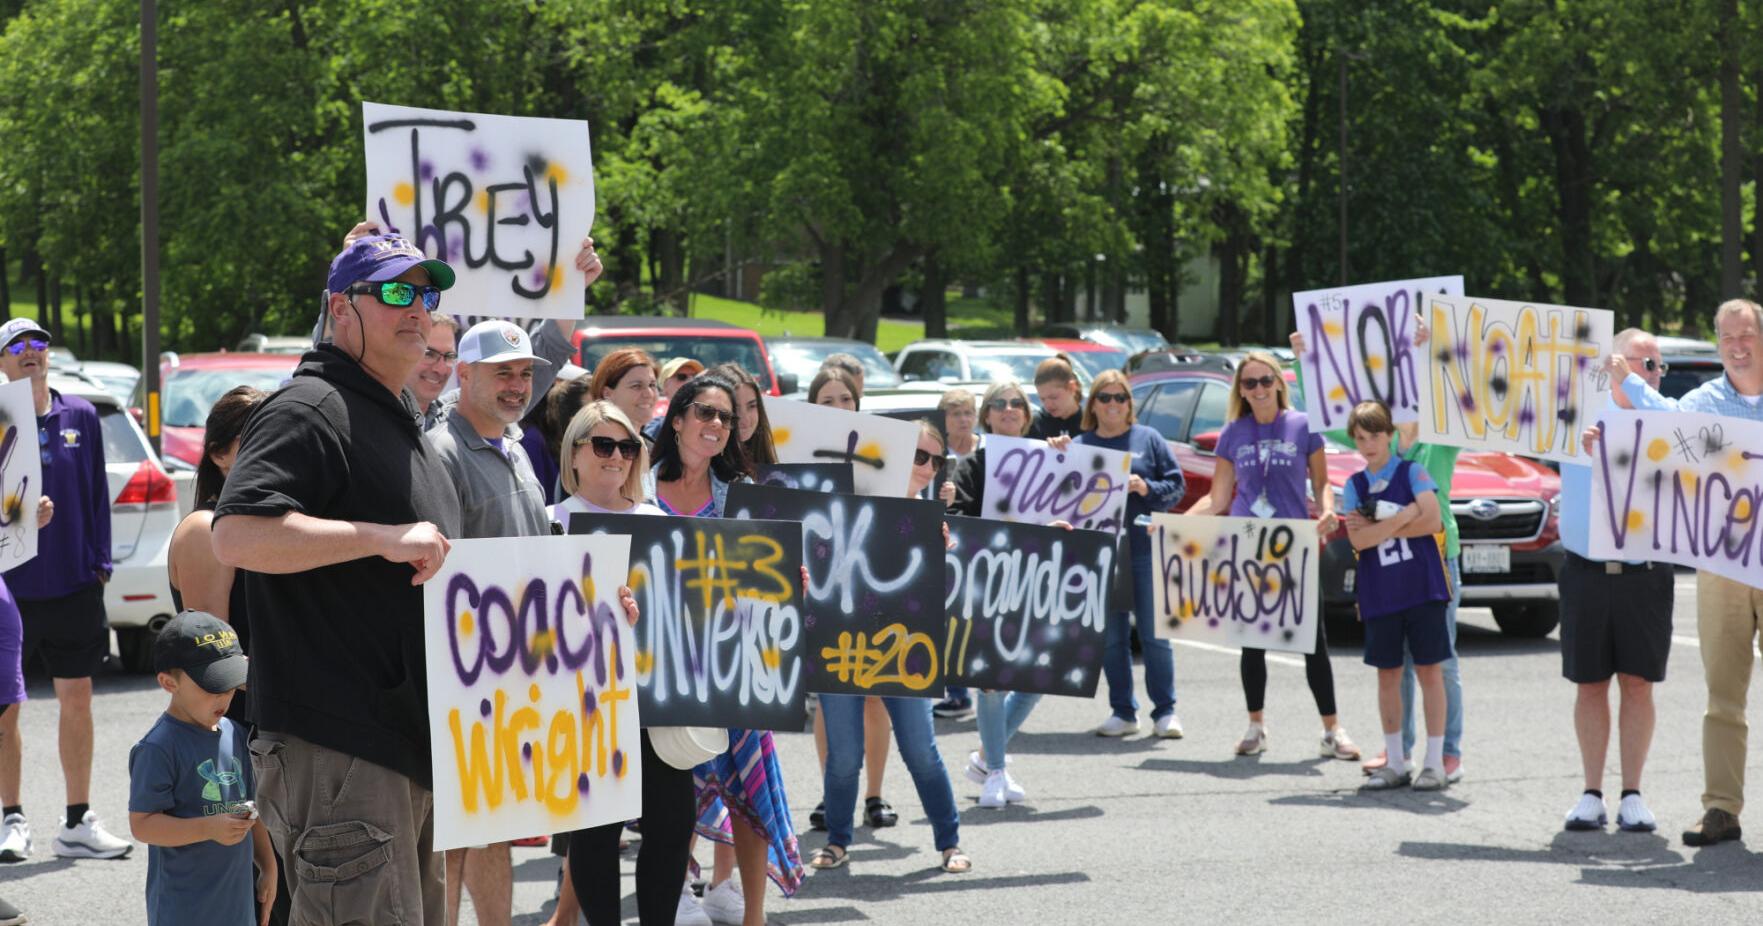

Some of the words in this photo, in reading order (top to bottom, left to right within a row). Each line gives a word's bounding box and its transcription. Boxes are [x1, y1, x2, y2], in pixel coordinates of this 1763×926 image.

[1307, 289, 1446, 427] NOR
[1430, 300, 1600, 457] NOAH
[675, 531, 792, 609] #3
[1377, 536, 1414, 567] 21
[822, 623, 938, 690] #20
